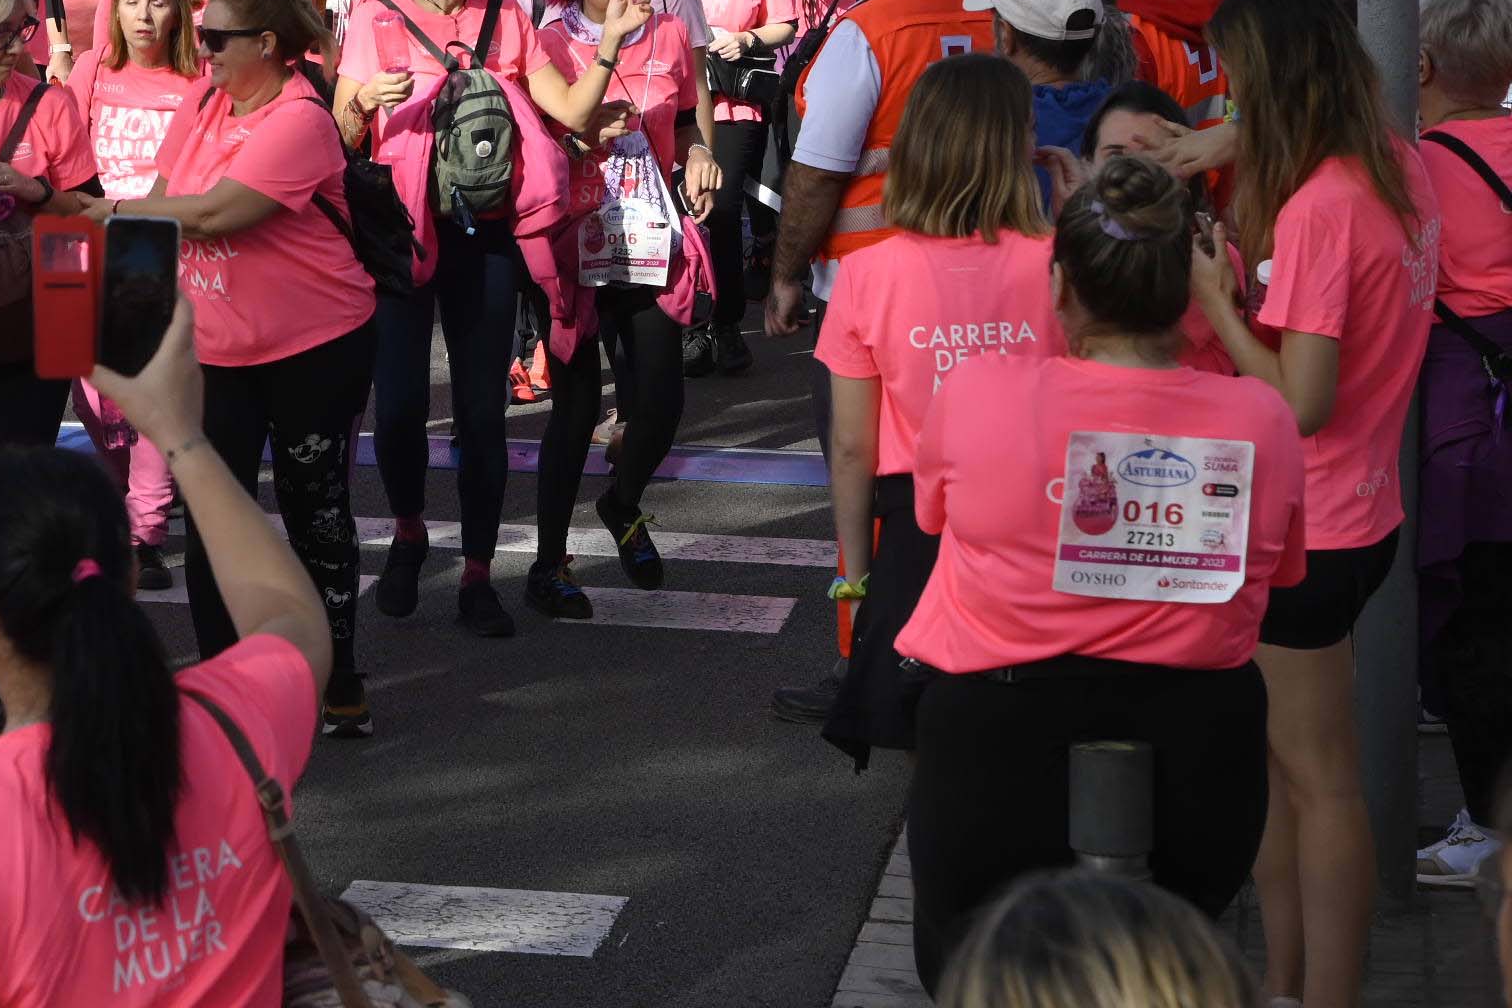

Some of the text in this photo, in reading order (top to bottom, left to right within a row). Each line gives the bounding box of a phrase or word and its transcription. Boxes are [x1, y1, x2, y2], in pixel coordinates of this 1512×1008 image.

[607, 233, 638, 246] 016
[909, 320, 1037, 351] CARRERA
[1122, 460, 1192, 482] ASTURIANA
[1123, 501, 1185, 527] 016
[1125, 530, 1176, 548] 27213
[1078, 549, 1227, 569] CARRERA DE LA MUJER 2023
[1070, 570, 1229, 594] OYSHO Santander
[78, 837, 243, 923] CAERA
[114, 888, 216, 953] DE LA
[113, 921, 229, 995] MUJER
